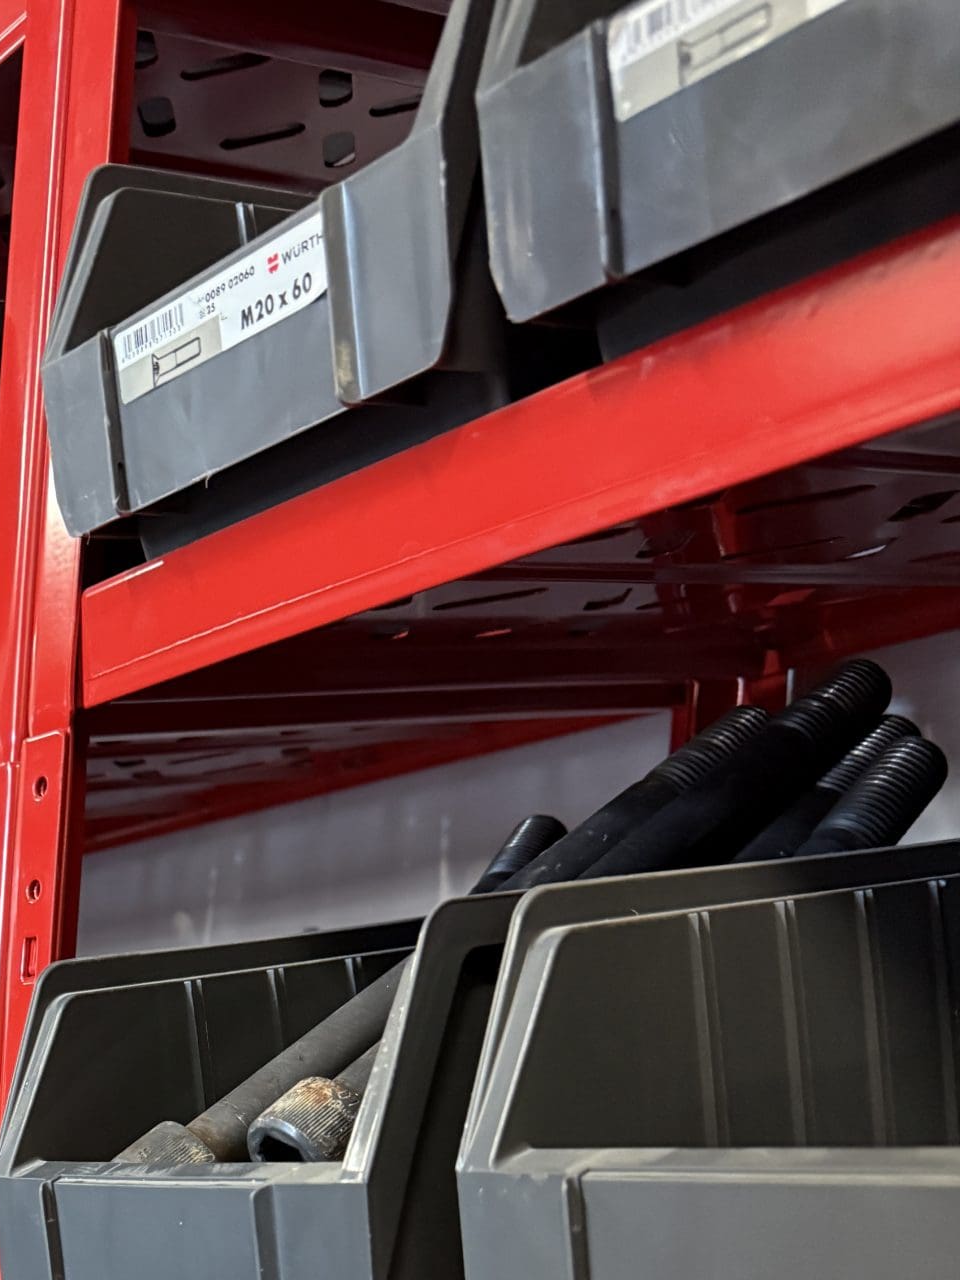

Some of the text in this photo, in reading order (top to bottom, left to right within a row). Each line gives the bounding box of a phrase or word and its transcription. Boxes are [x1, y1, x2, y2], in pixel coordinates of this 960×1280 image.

[281, 232, 324, 265] WÜRTH
[204, 265, 255, 303] 0089 02060
[241, 271, 313, 330] M20 x 60
